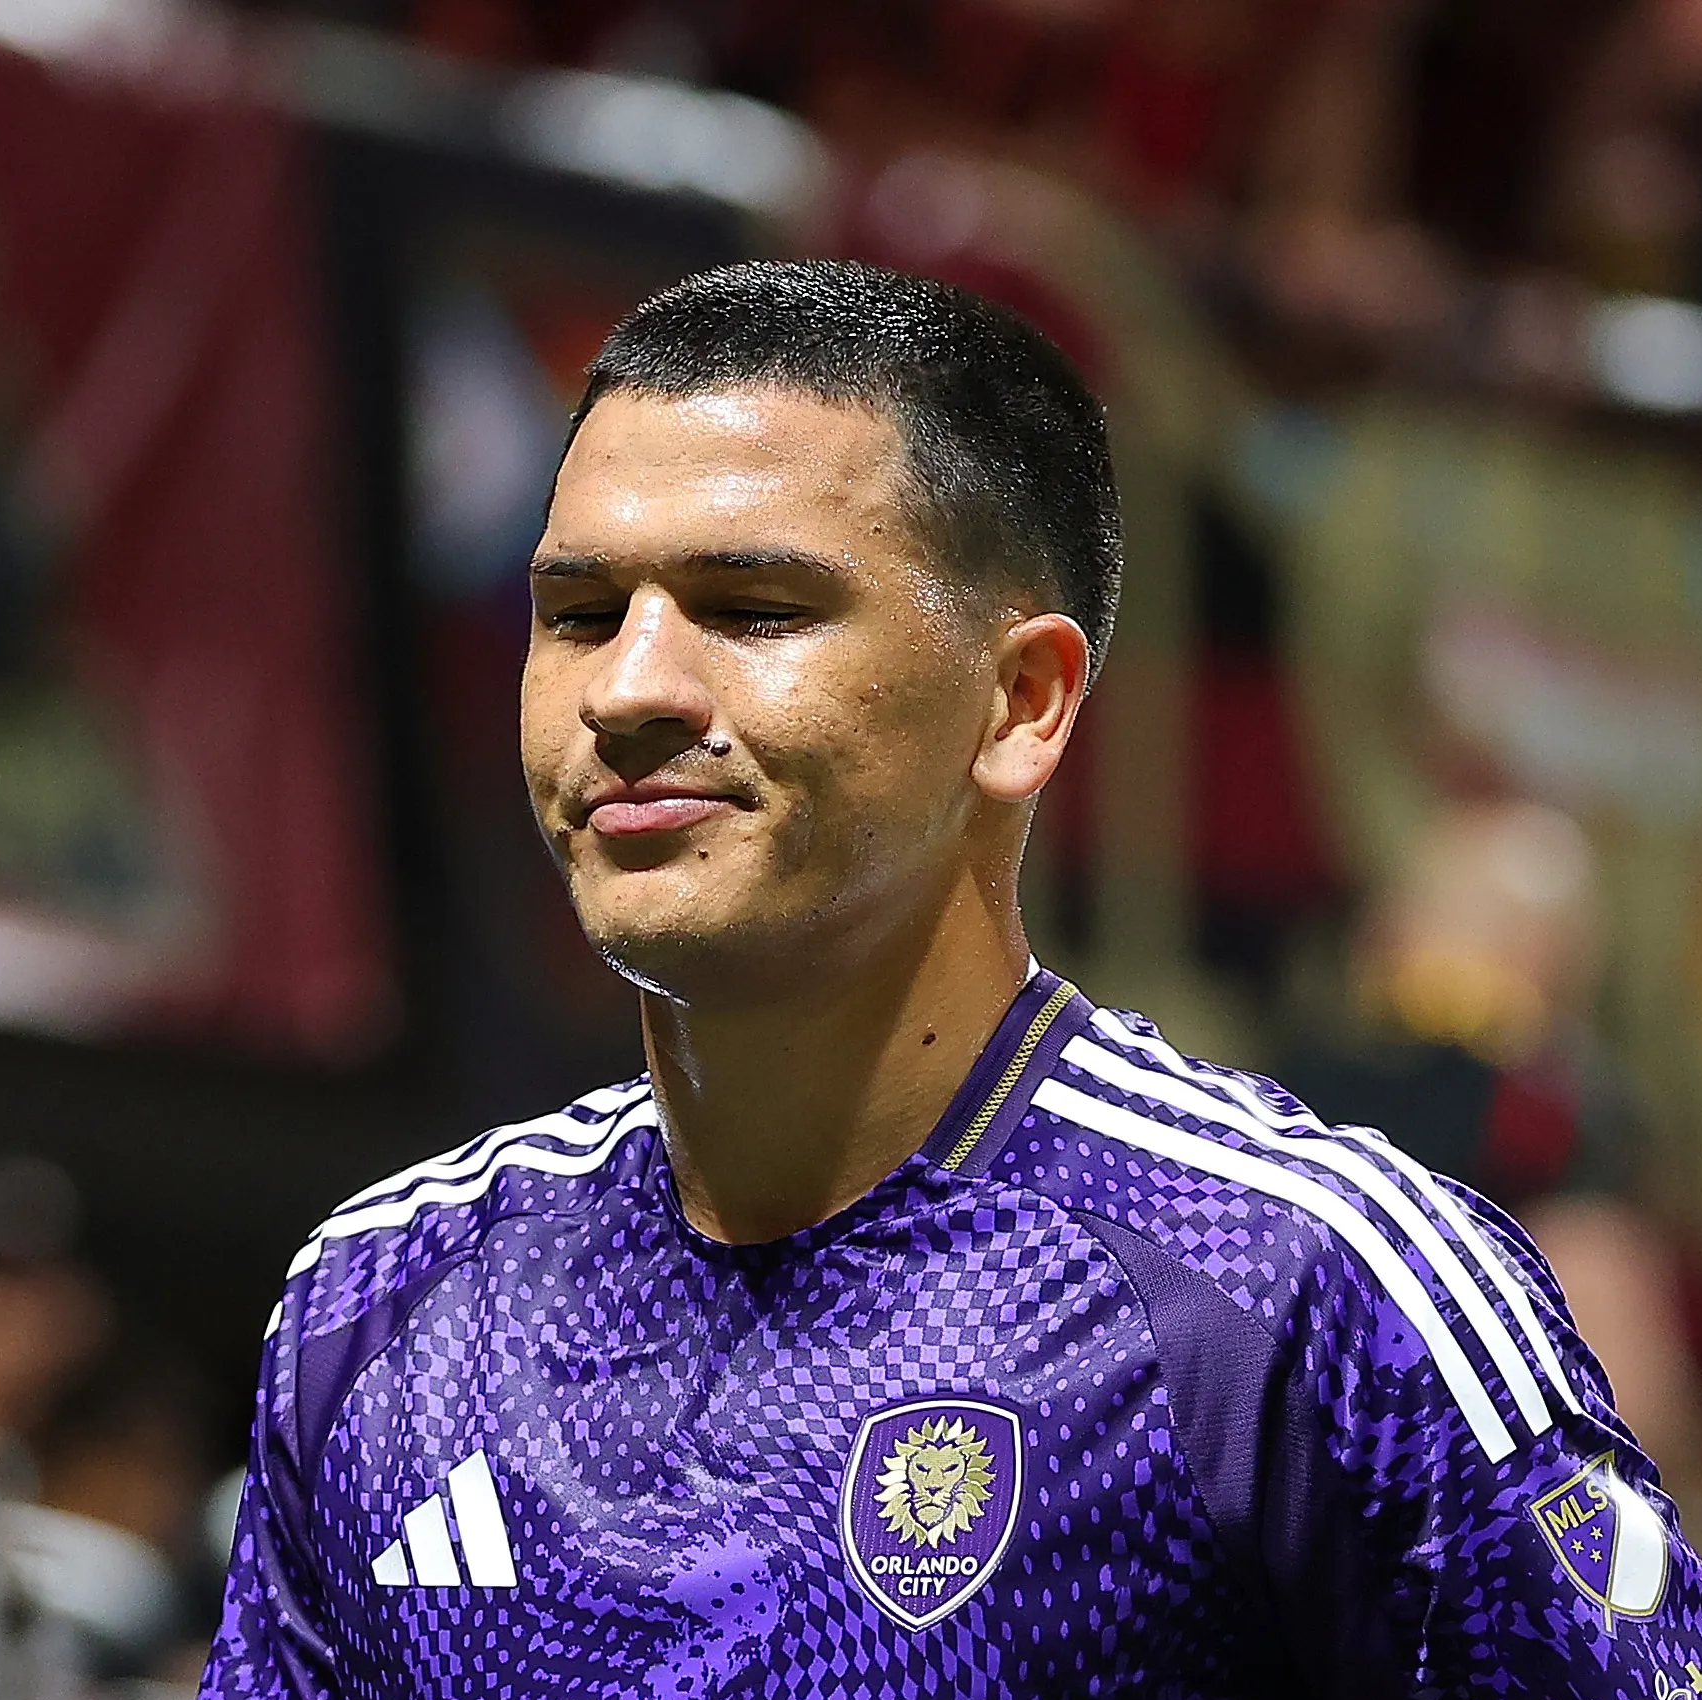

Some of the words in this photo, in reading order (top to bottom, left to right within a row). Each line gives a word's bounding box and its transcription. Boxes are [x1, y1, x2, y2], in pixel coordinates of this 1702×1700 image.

[1545, 1481, 1610, 1539] MLS
[870, 1555, 978, 1575] ORLANDO
[898, 1575, 947, 1596] CITY
